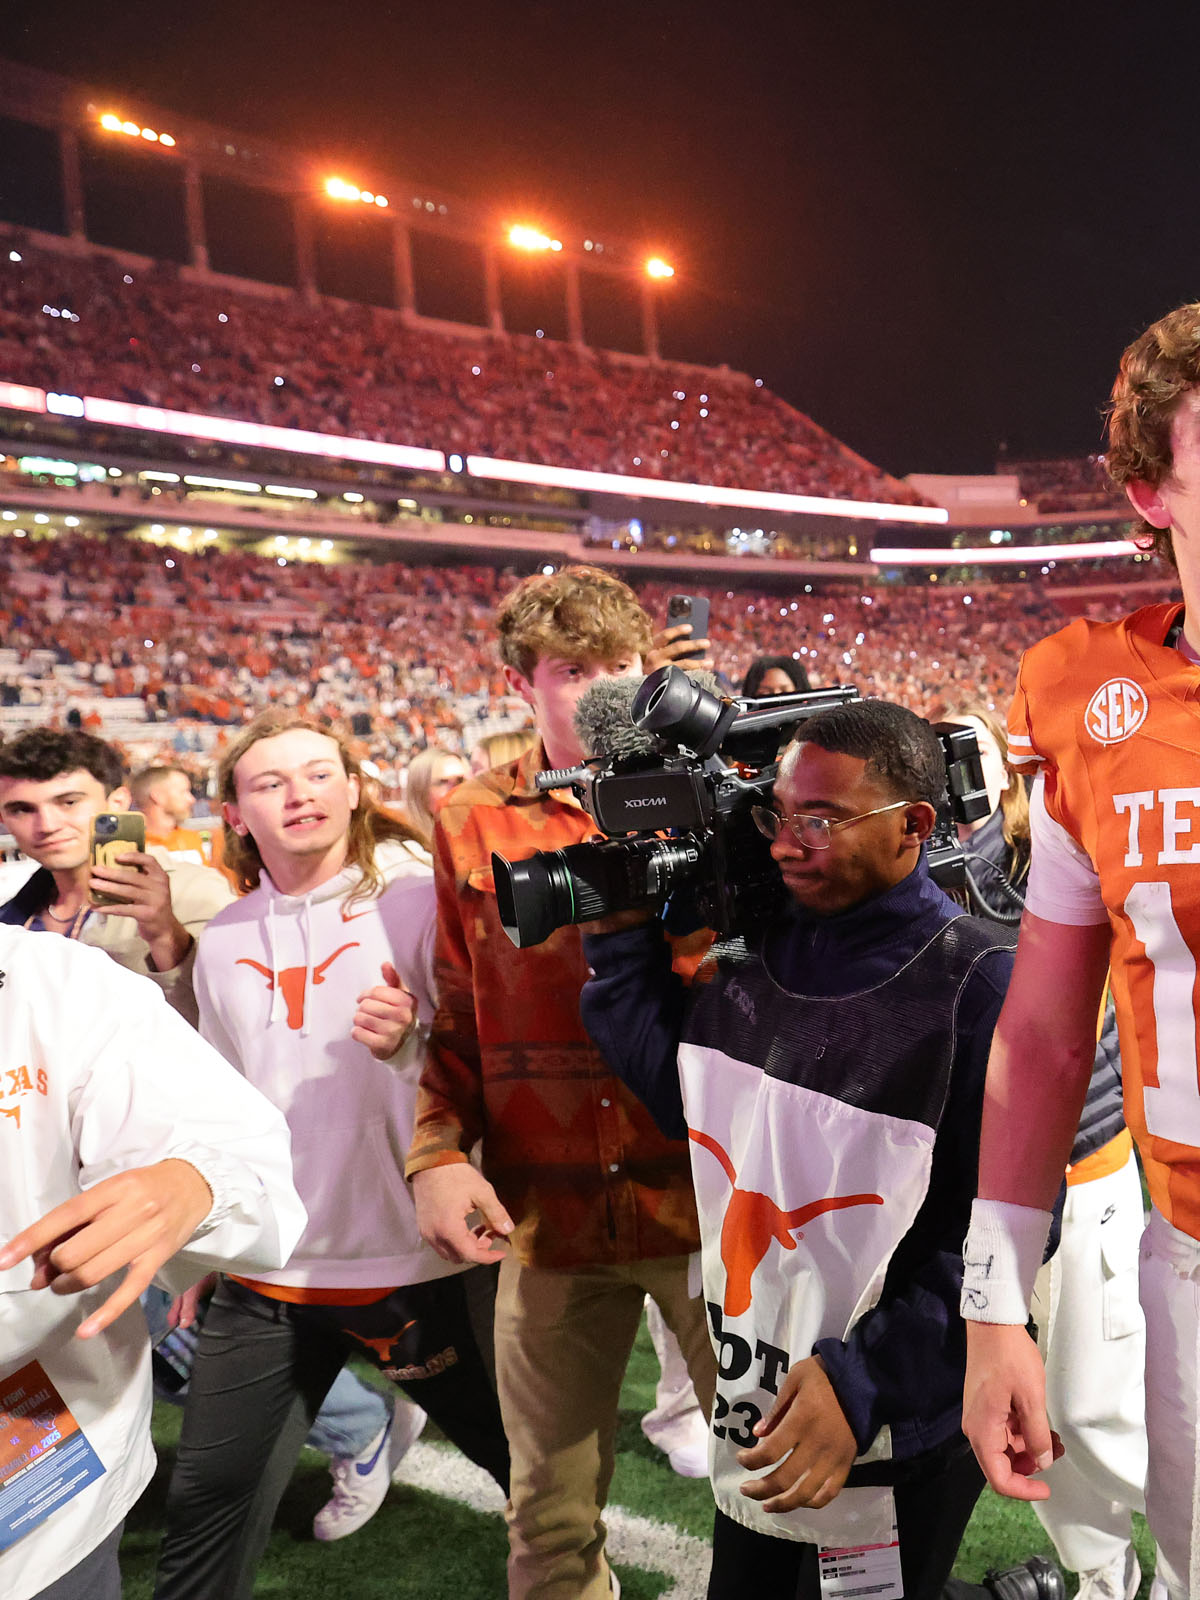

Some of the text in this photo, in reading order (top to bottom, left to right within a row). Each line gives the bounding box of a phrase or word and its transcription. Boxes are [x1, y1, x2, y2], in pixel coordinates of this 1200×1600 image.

[1091, 682, 1141, 738] SEC
[624, 797, 667, 808] XDCAM
[0, 1065, 48, 1098] XAS
[40, 1429, 62, 1449] 2025
